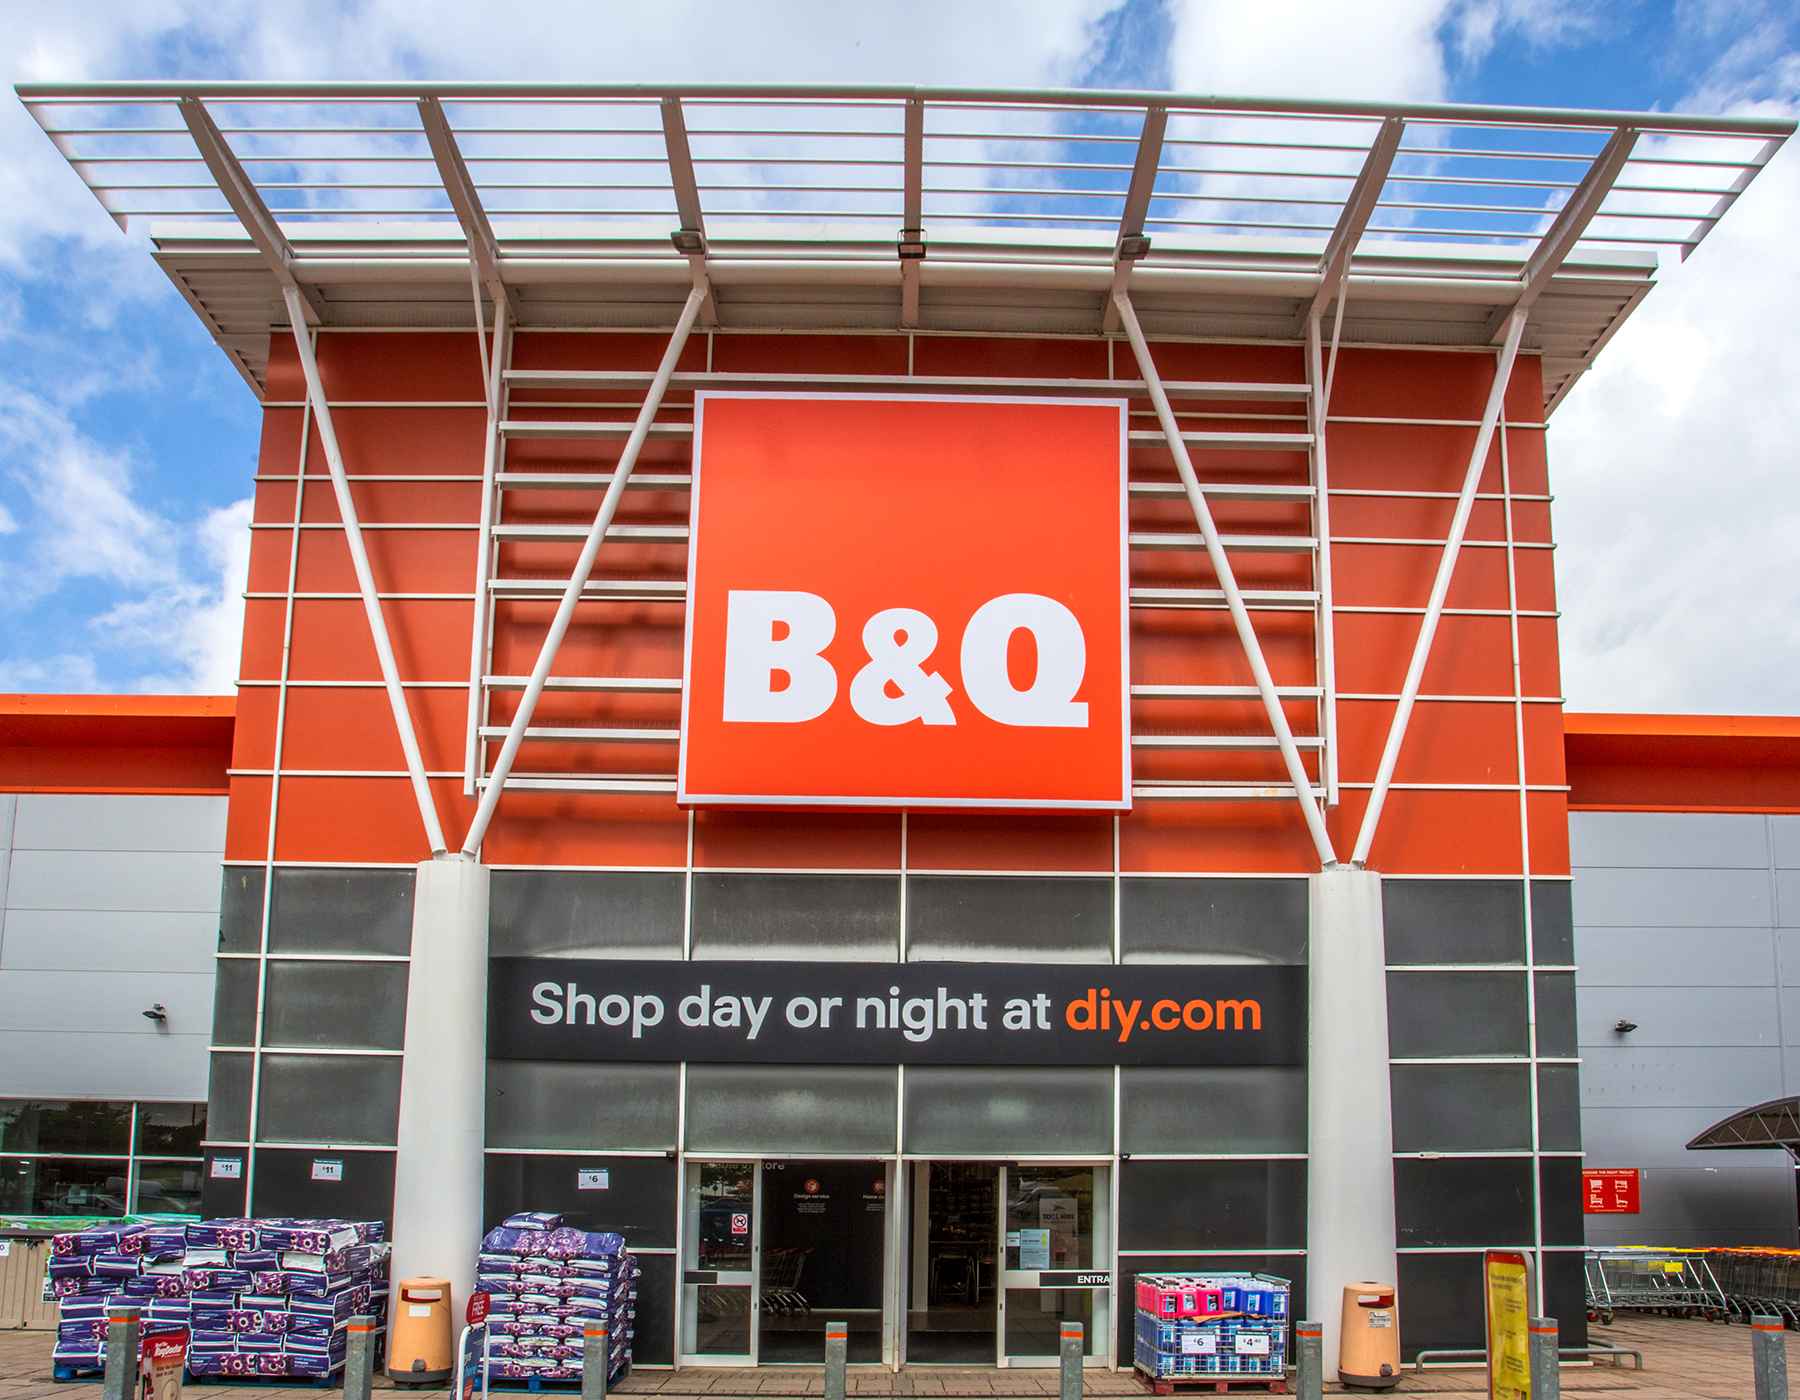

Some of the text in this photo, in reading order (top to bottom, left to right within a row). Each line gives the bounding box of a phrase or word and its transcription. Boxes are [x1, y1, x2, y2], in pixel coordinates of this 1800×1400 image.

[723, 590, 1089, 727] B&Q
[530, 982, 1262, 1043] Shop day or night at diy.com
[1078, 1275, 1110, 1284] ENTRA
[472, 1300, 485, 1317] FREE
[1194, 1338, 1204, 1346] £6
